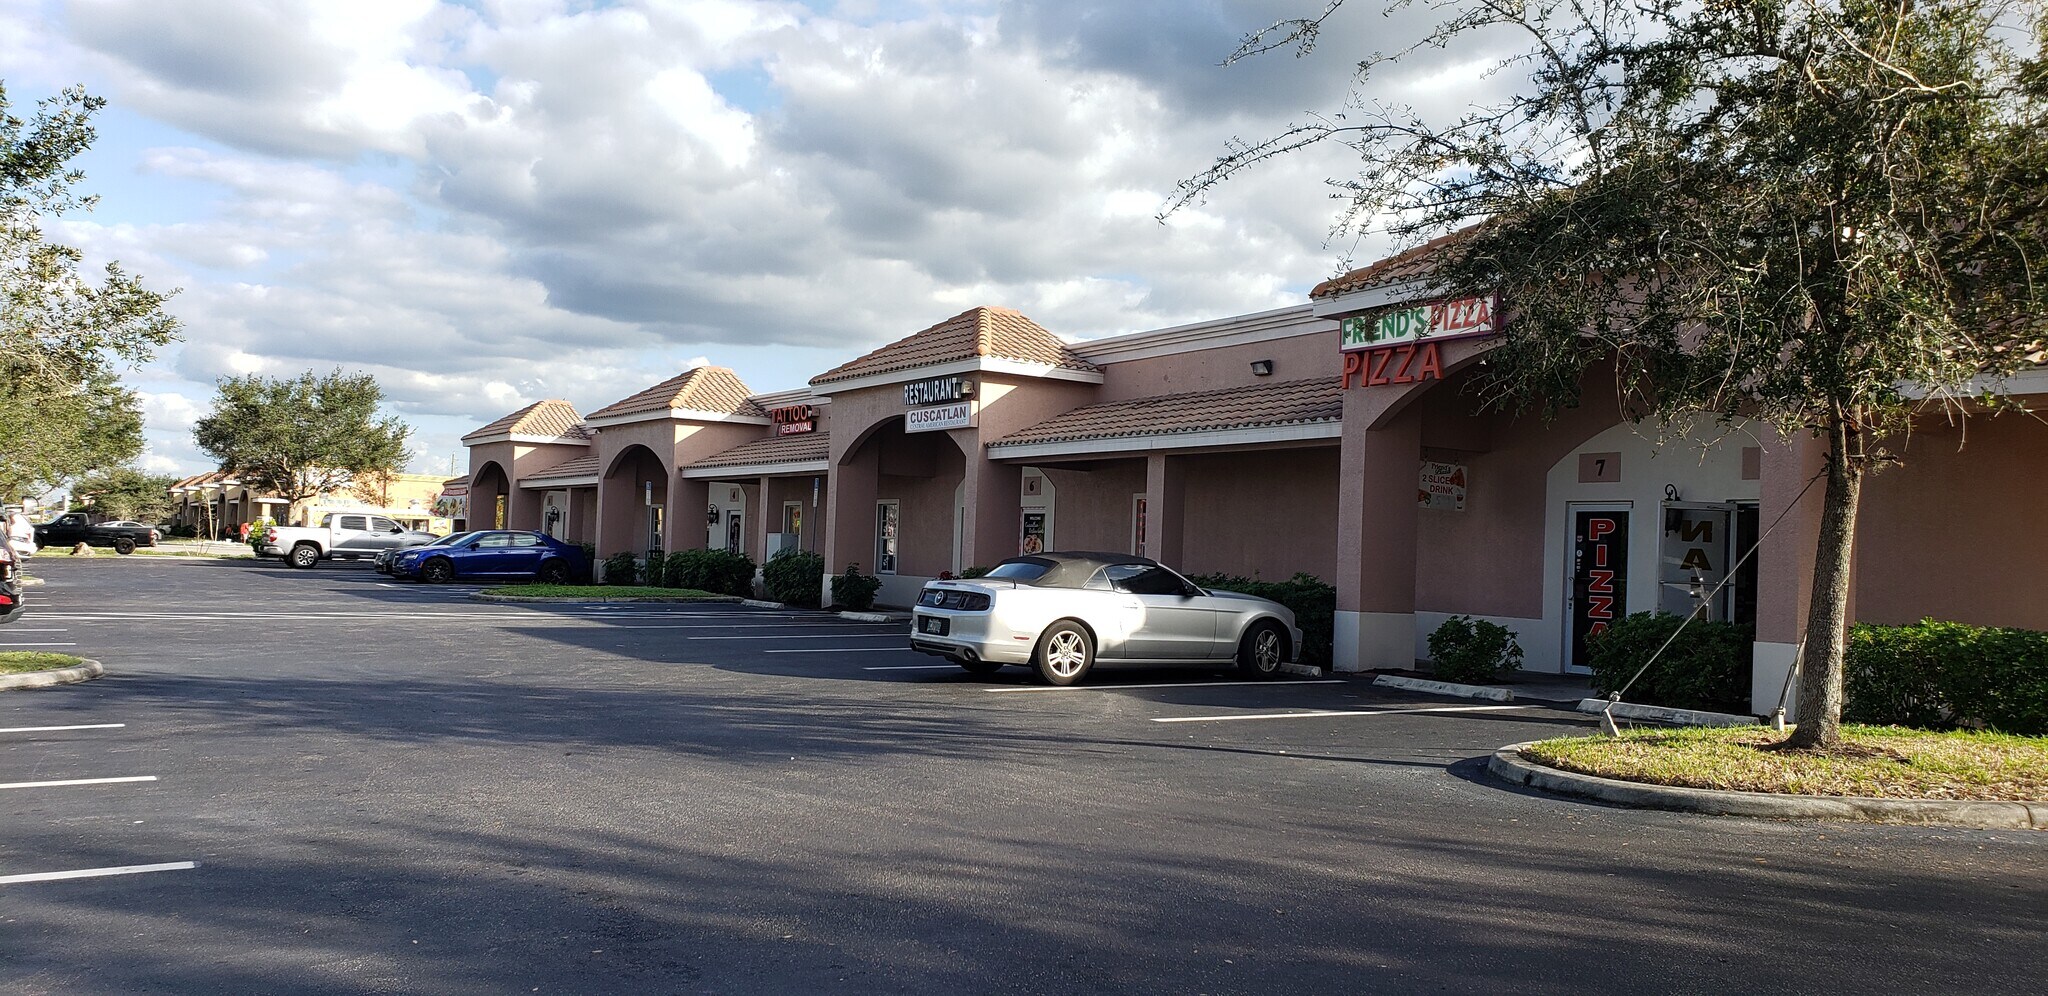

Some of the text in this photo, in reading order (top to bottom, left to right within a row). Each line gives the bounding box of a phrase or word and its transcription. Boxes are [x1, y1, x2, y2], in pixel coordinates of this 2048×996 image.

[1342, 298, 1490, 346] FREND'S PIZZA
[1342, 343, 1443, 389] PIZZA
[904, 377, 958, 405] RESTAURANT
[771, 404, 808, 424] TATTOO
[910, 406, 967, 423] CUSCATLAN
[781, 422, 811, 433] REMOVAL
[1595, 459, 1605, 476] 7
[1029, 481, 1035, 491] 6
[1422, 474, 1427, 482] 2
[1429, 485, 1453, 494] DRINK
